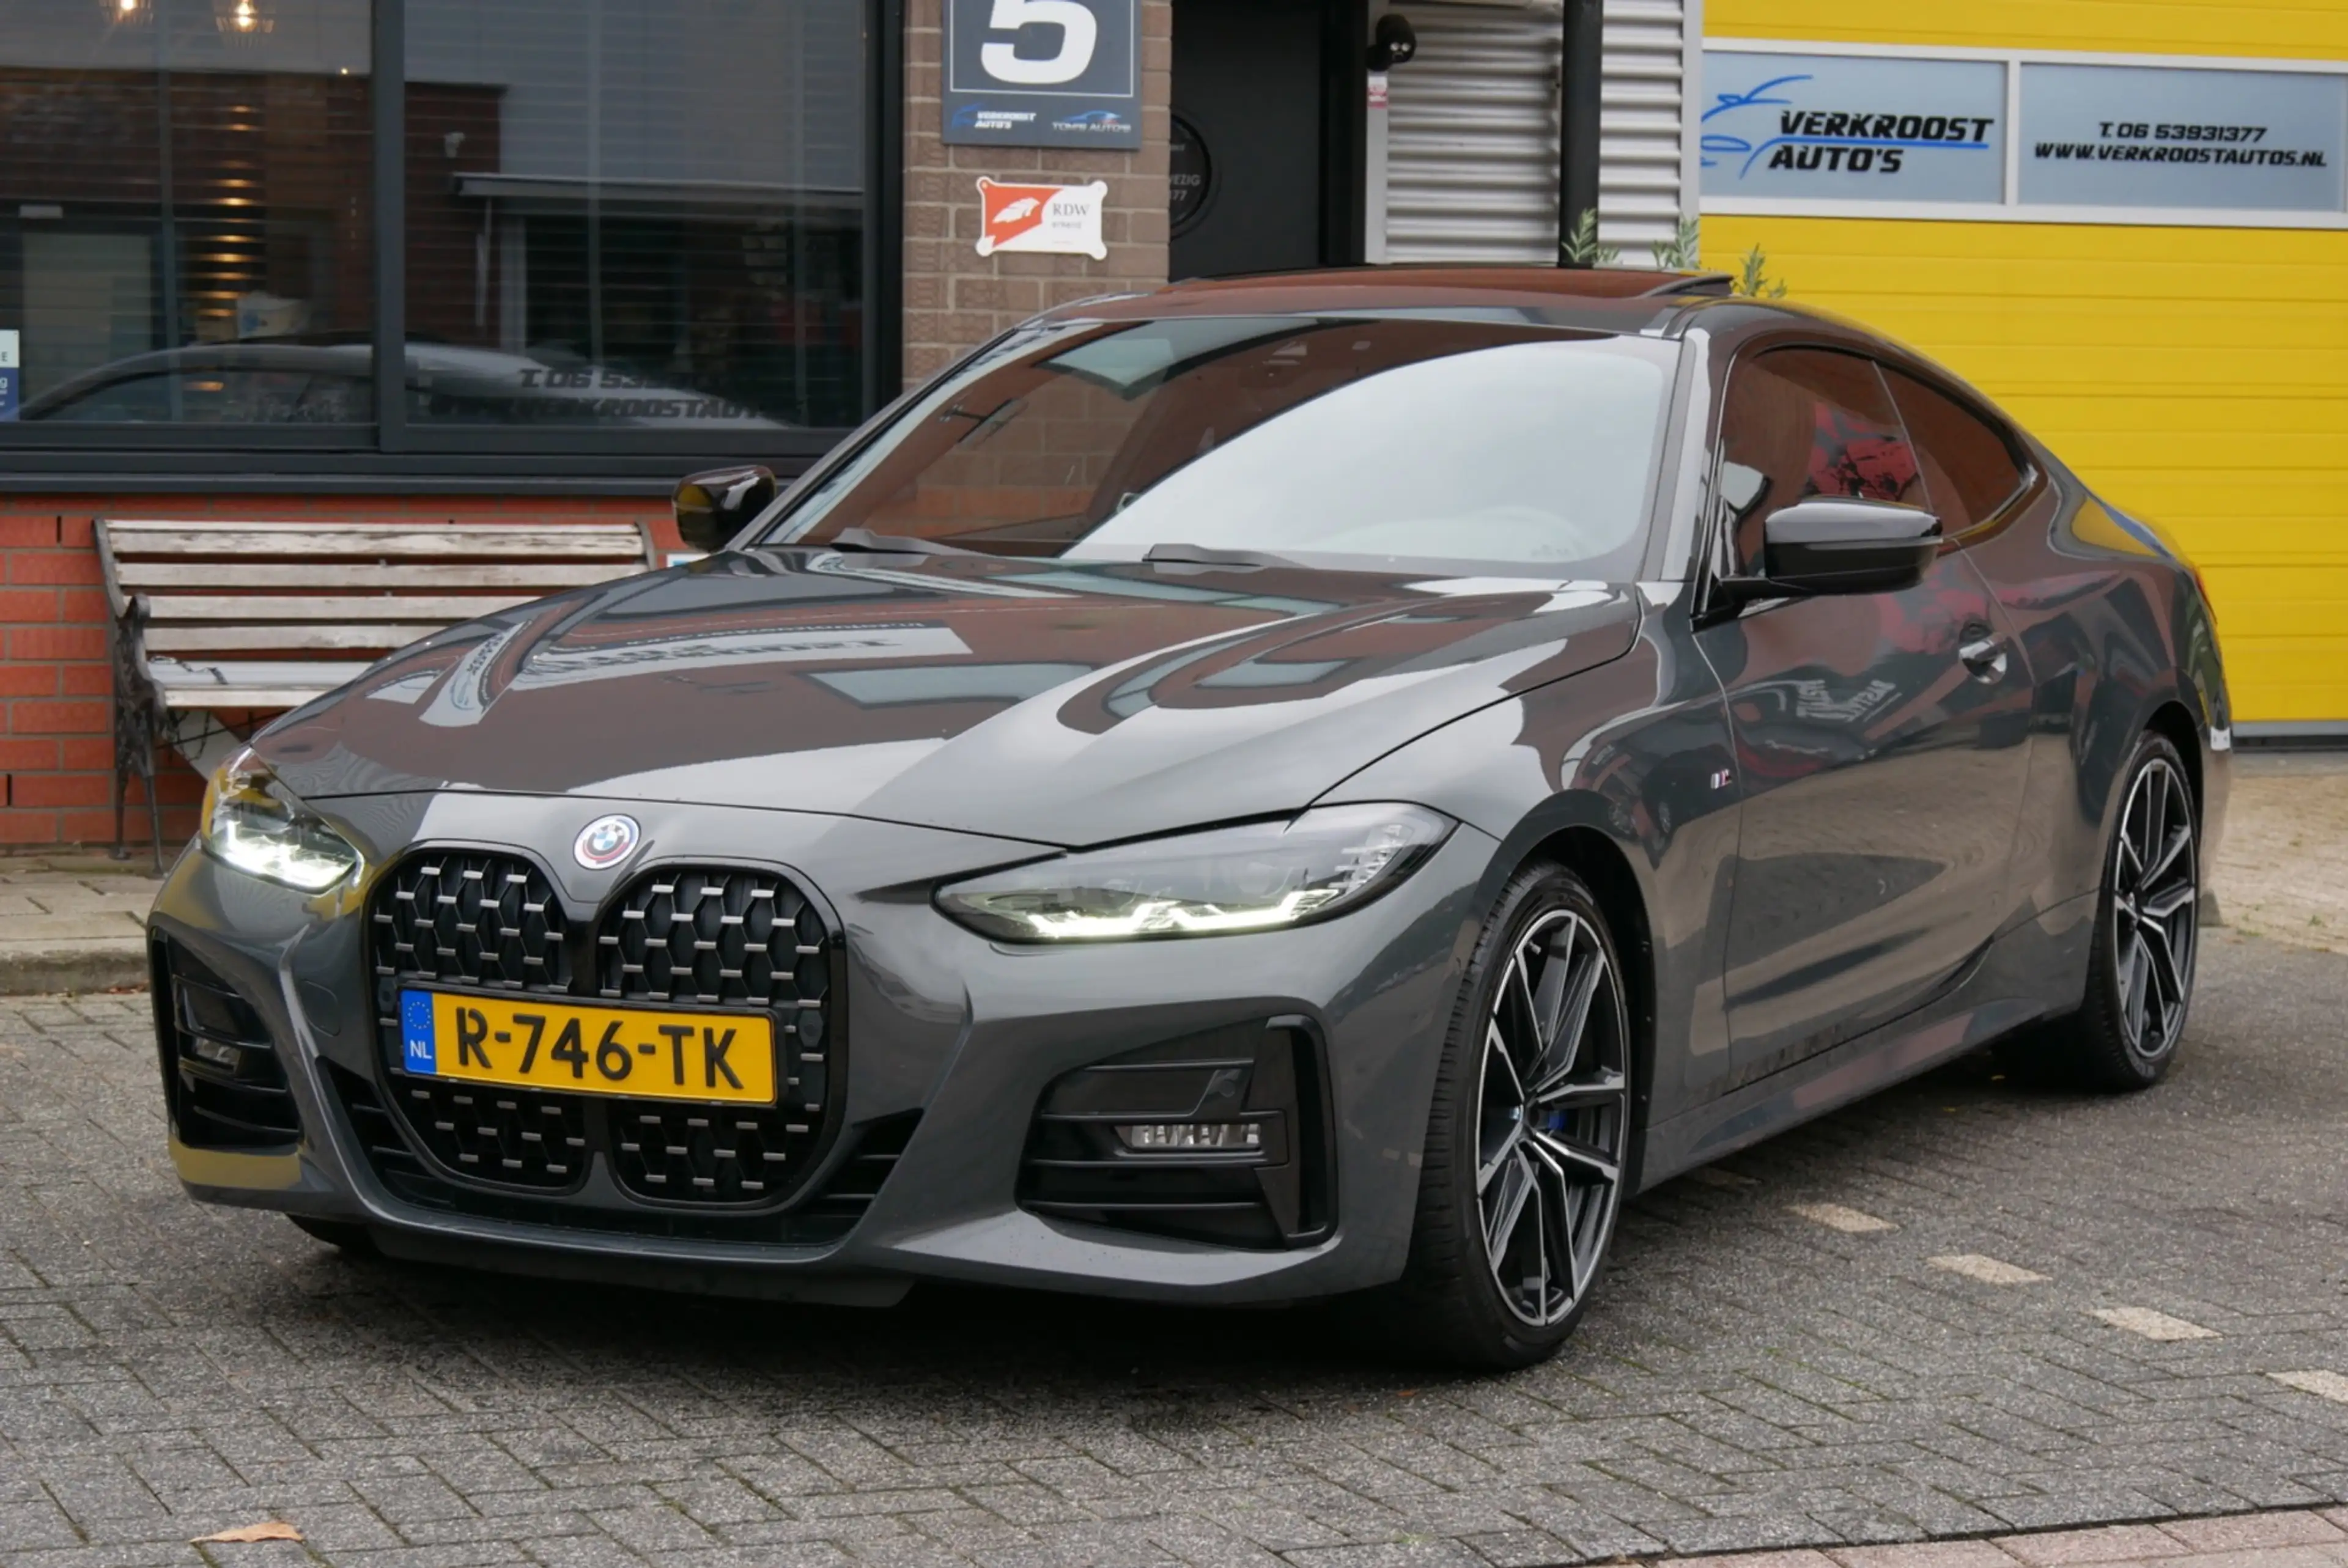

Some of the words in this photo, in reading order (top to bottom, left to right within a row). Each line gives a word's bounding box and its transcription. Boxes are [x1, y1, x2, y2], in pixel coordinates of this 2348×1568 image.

[981, 0, 1097, 84] 5
[1780, 110, 1995, 142] VERKROOST
[2154, 124, 2268, 143] 53931377
[1768, 144, 1904, 173] AUTO'S
[2034, 142, 2327, 167] WWW.VERKROOSTAUTOS.NL
[1053, 202, 1091, 216] RDW
[410, 1039, 433, 1060] NL
[456, 1006, 745, 1090] R-746-TK
